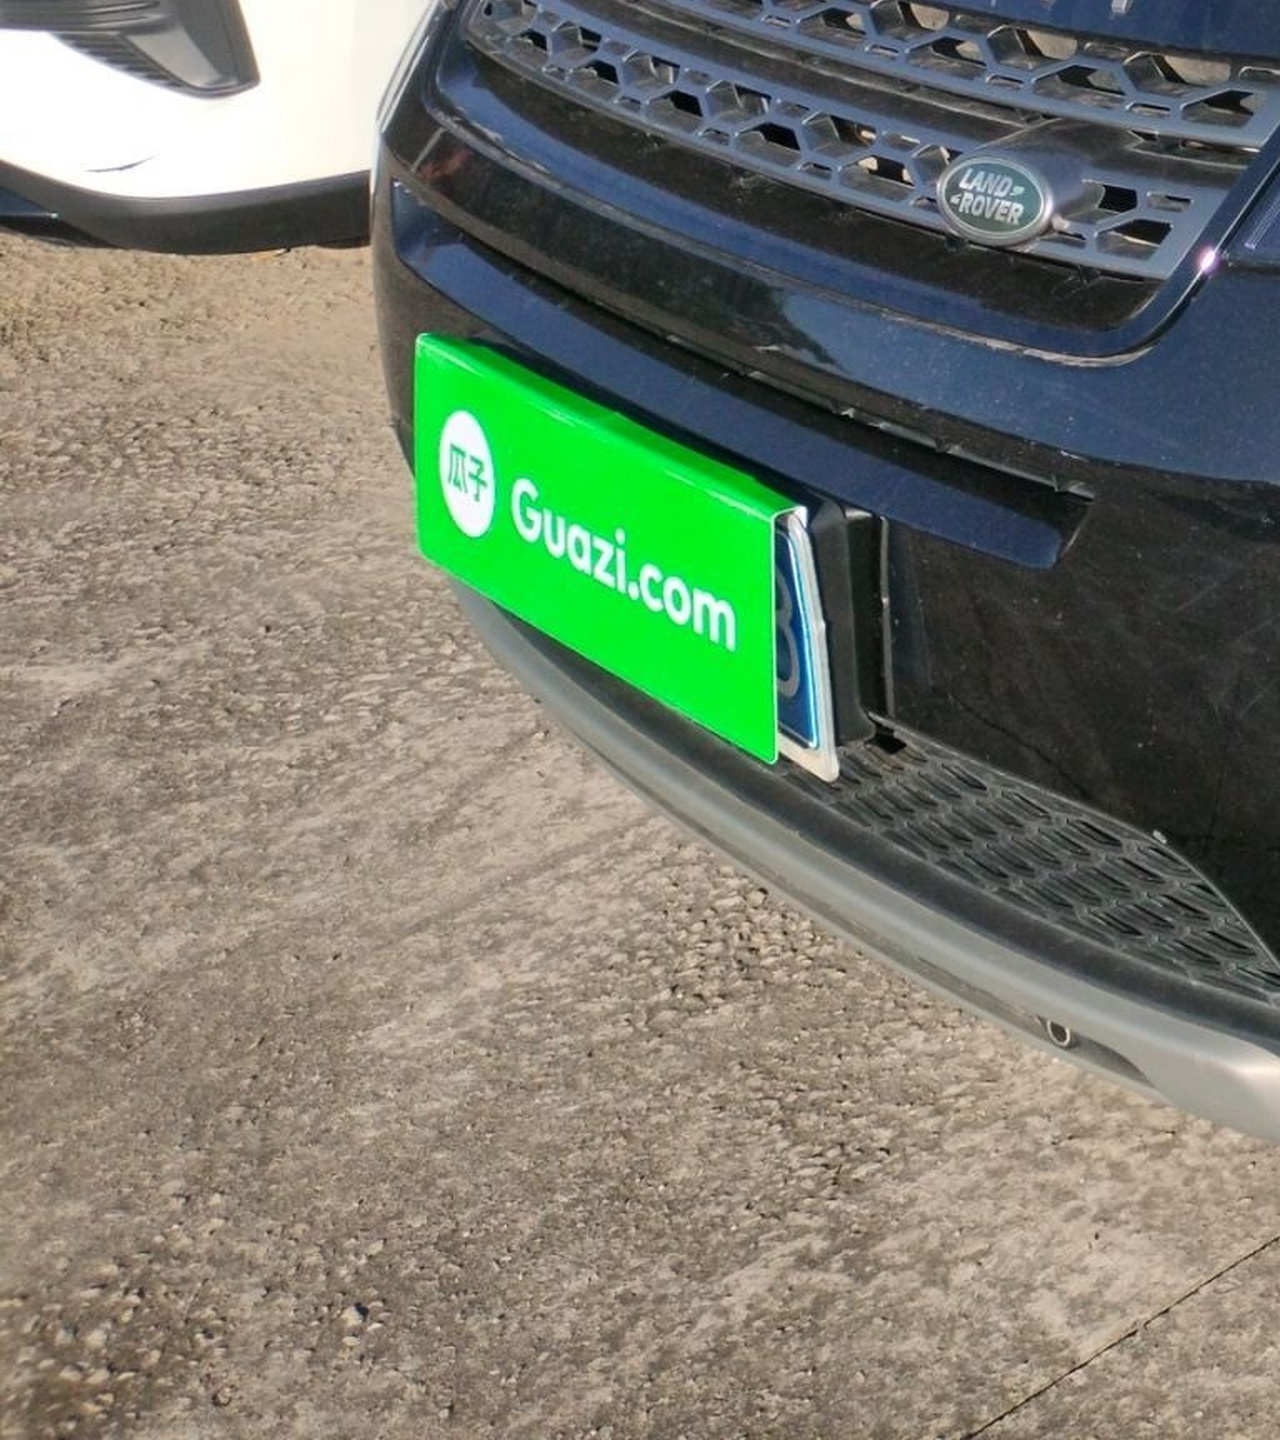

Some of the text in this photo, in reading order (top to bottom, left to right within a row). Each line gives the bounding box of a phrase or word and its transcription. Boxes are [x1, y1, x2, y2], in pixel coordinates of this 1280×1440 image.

[959, 168, 1013, 197] LAND
[959, 191, 1024, 225] ROVER
[448, 443, 487, 502] 瓜子
[511, 477, 737, 653] Guazi.com
